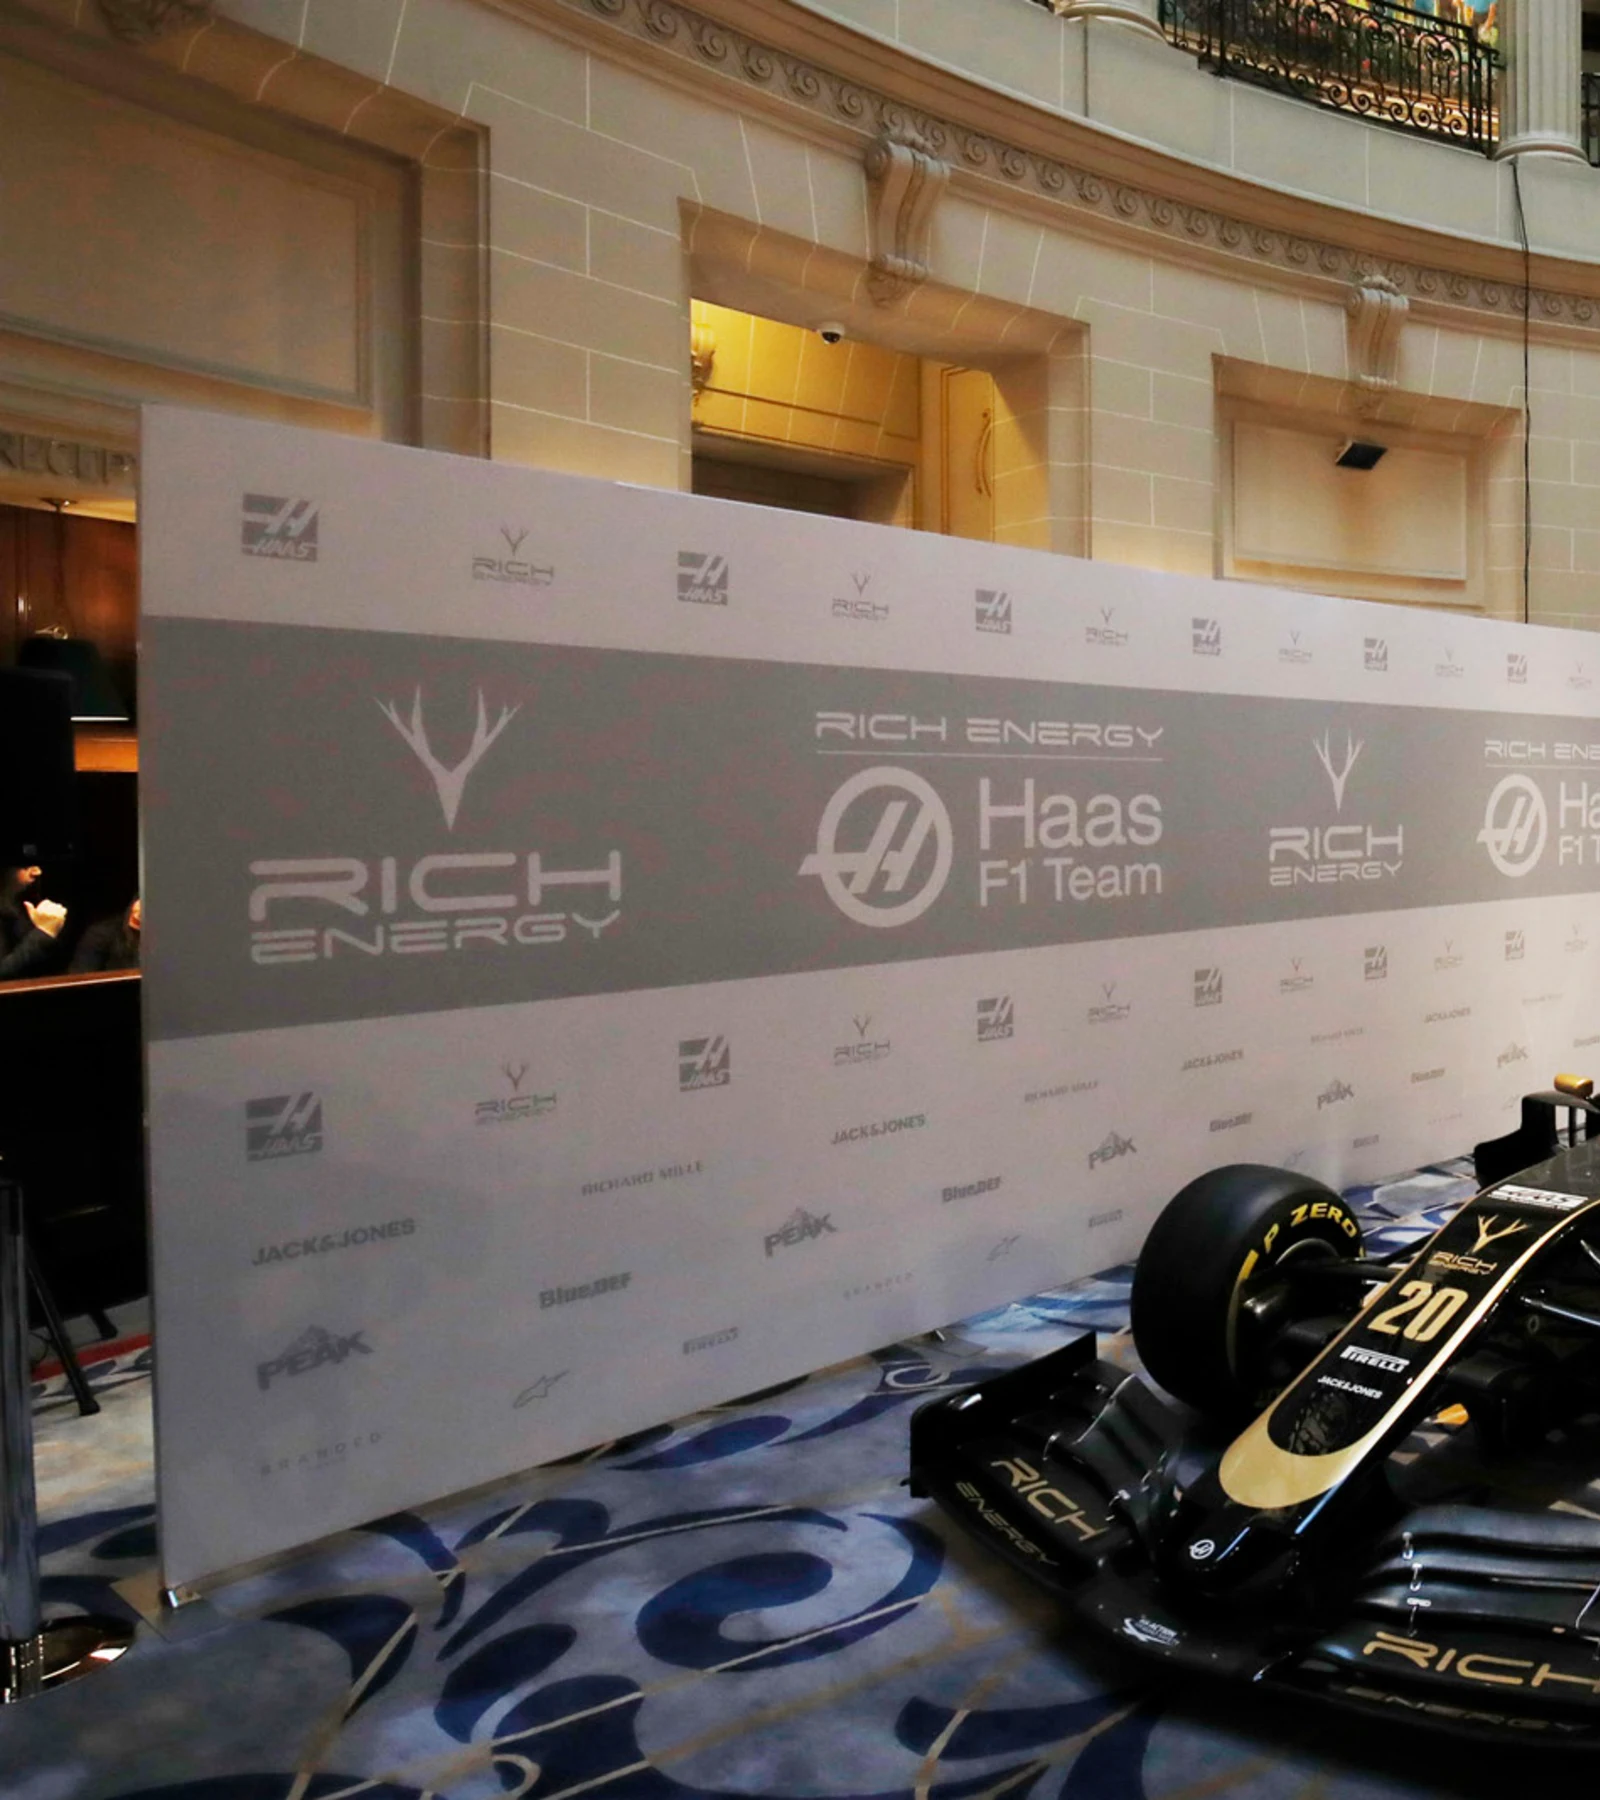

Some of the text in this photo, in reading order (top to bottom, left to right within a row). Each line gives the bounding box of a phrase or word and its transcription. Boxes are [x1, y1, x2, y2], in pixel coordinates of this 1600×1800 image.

[253, 536, 308, 558] HAAS
[472, 557, 554, 577] RICH
[832, 598, 889, 615] RICH
[816, 712, 1164, 748] RICH ENERGY
[1484, 740, 1546, 760] RICH
[979, 777, 1163, 850] Haas
[1269, 825, 1403, 864] RICH
[1559, 838, 1586, 866] F1
[248, 850, 621, 922] RICH
[979, 857, 1163, 907] F1 Team
[1269, 861, 1403, 887] ENERGY
[250, 909, 621, 965] ENERGY
[834, 1041, 890, 1058] RICH
[475, 1093, 557, 1116] RICH
[260, 1132, 320, 1158] HAAS
[830, 1114, 926, 1145] JACK&JONES
[1088, 1136, 1138, 1169] PEAK
[581, 1160, 705, 1197] RICHARD MILLE
[252, 1217, 416, 1267] JACK&JONES
[765, 1212, 837, 1258] PEAK
[1264, 1202, 1357, 1254] P ZERO
[1433, 1251, 1498, 1272] RICH
[1367, 1280, 1469, 1342] 20
[256, 1330, 374, 1391] PEAK
[1339, 1345, 1410, 1373] PIRELLI
[1317, 1375, 1383, 1399] JACK&JONES
[990, 1457, 1111, 1541] RICH
[954, 1480, 1060, 1566] ENERGY
